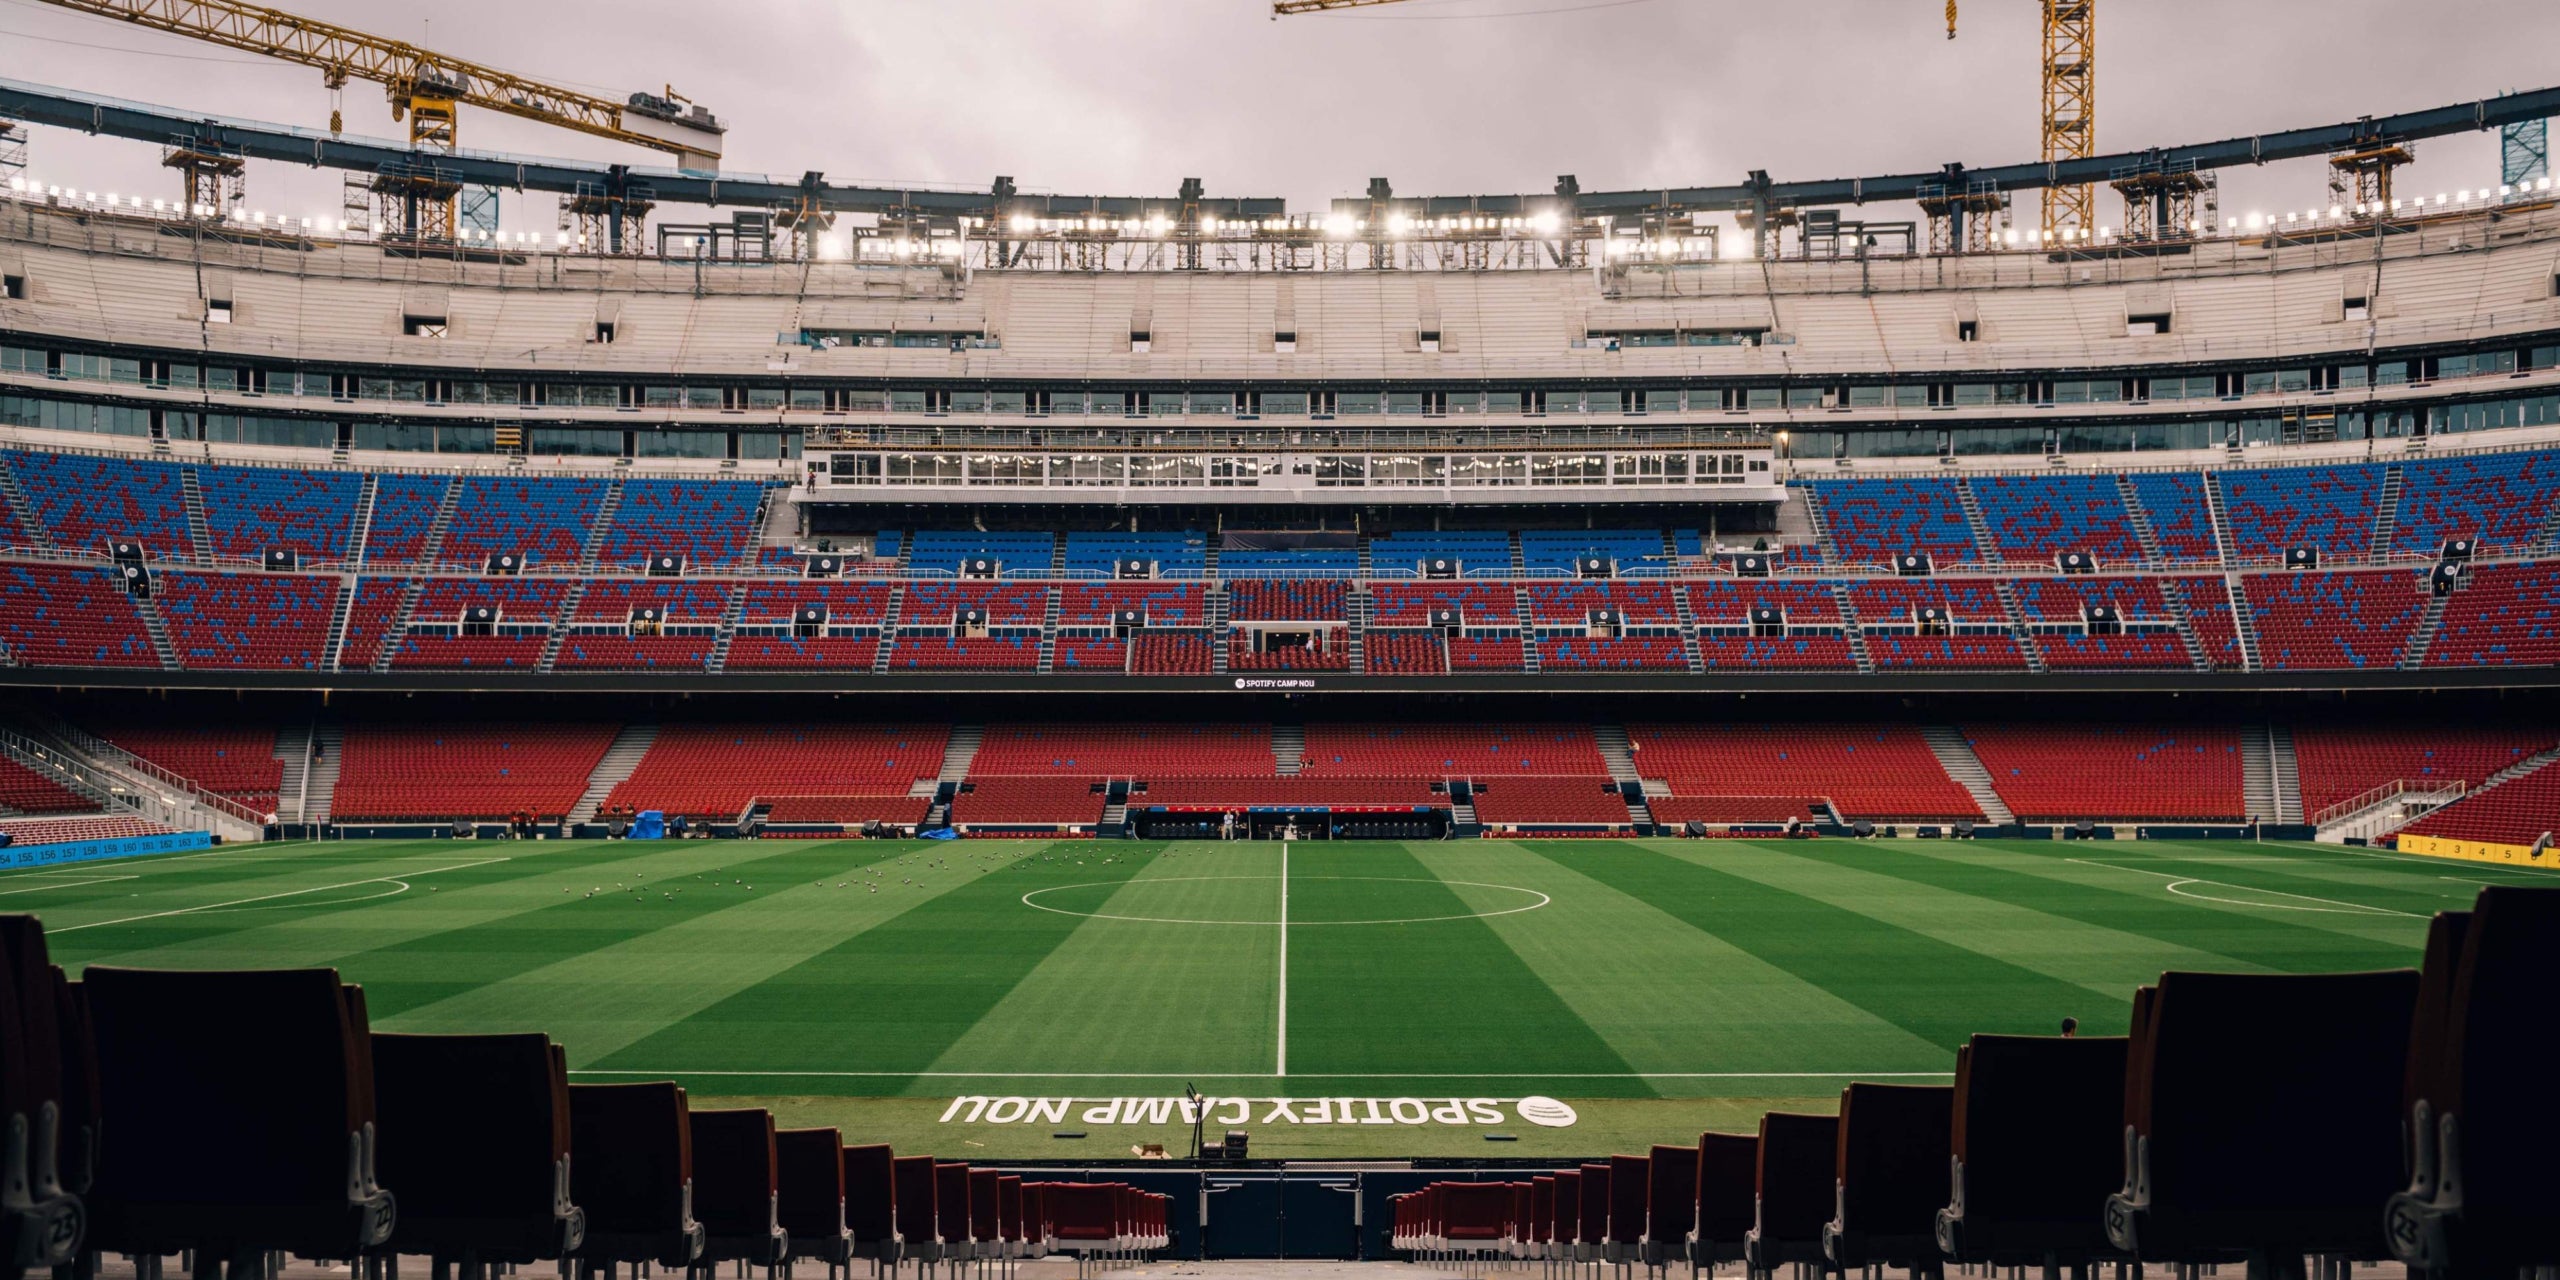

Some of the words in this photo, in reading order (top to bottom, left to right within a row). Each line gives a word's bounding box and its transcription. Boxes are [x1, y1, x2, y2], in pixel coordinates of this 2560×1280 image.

[1246, 679, 1276, 688] SPOTIFY
[1277, 679, 1298, 688] CAMP
[1299, 679, 1315, 688] NOU
[18, 852, 34, 863] 155
[40, 850, 56, 860] 156
[62, 848, 76, 858] 157
[83, 846, 98, 856] 158
[104, 844, 118, 854] 159
[123, 843, 137, 853] 160
[142, 841, 154, 851] 161
[160, 840, 173, 849] 162
[178, 838, 191, 847] 163
[196, 836, 209, 846] 164
[2407, 840, 2412, 848] 1
[2430, 842, 2436, 851] 2
[2454, 845, 2461, 854] 3
[2479, 847, 2485, 856] 4
[2504, 850, 2511, 859] 5
[938, 1096, 1072, 1124] NOU
[1082, 1097, 1250, 1125] CAMP
[1262, 1097, 1505, 1125] SPOTIFY
[50, 1213, 73, 1244] 23
[2396, 1211, 2418, 1246] 23
